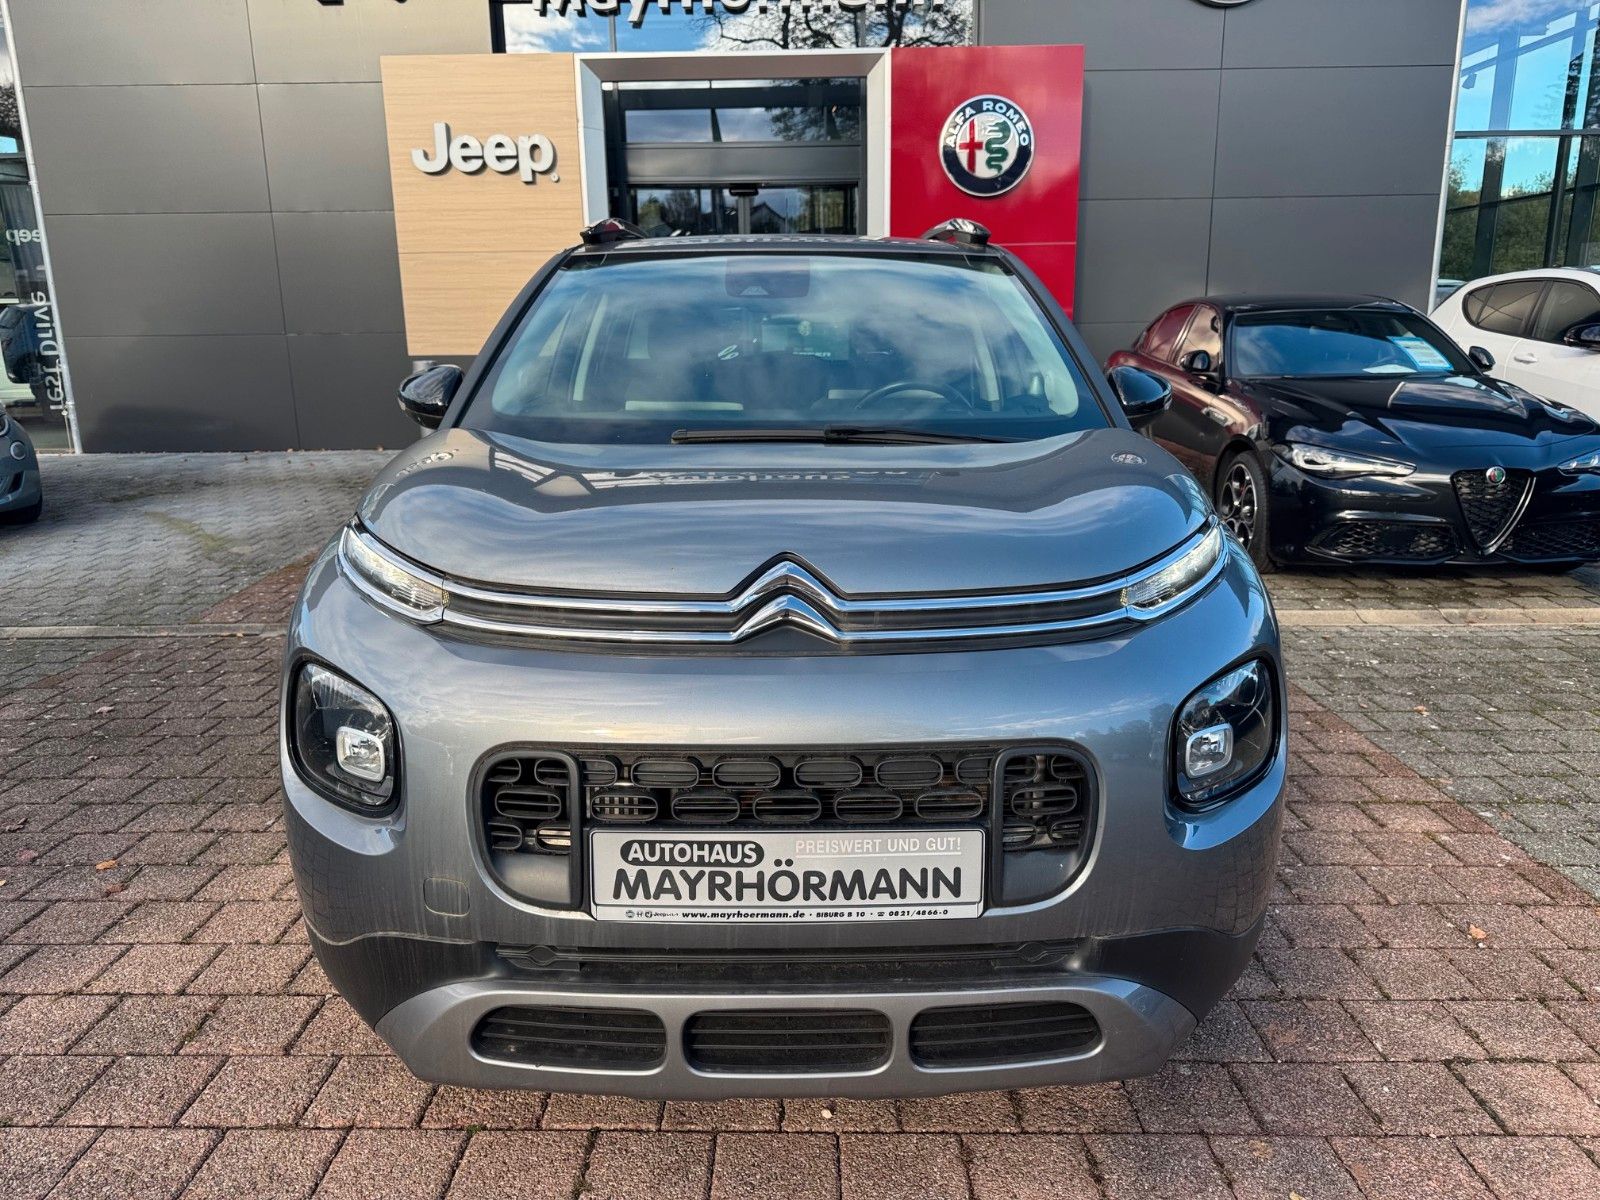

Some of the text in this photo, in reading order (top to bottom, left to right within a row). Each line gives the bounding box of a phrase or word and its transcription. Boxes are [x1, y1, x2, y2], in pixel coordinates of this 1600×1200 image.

[944, 100, 1030, 149] ALFA ROMEO
[411, 121, 555, 183] Jeep
[627, 842, 757, 864] AUTOHAUS
[794, 837, 961, 853] PREISWERT UND GUT!
[613, 858, 961, 902] MAYRHÖRMANN
[682, 910, 805, 919] www.mayrhoermann.de
[856, 910, 866, 918] 10
